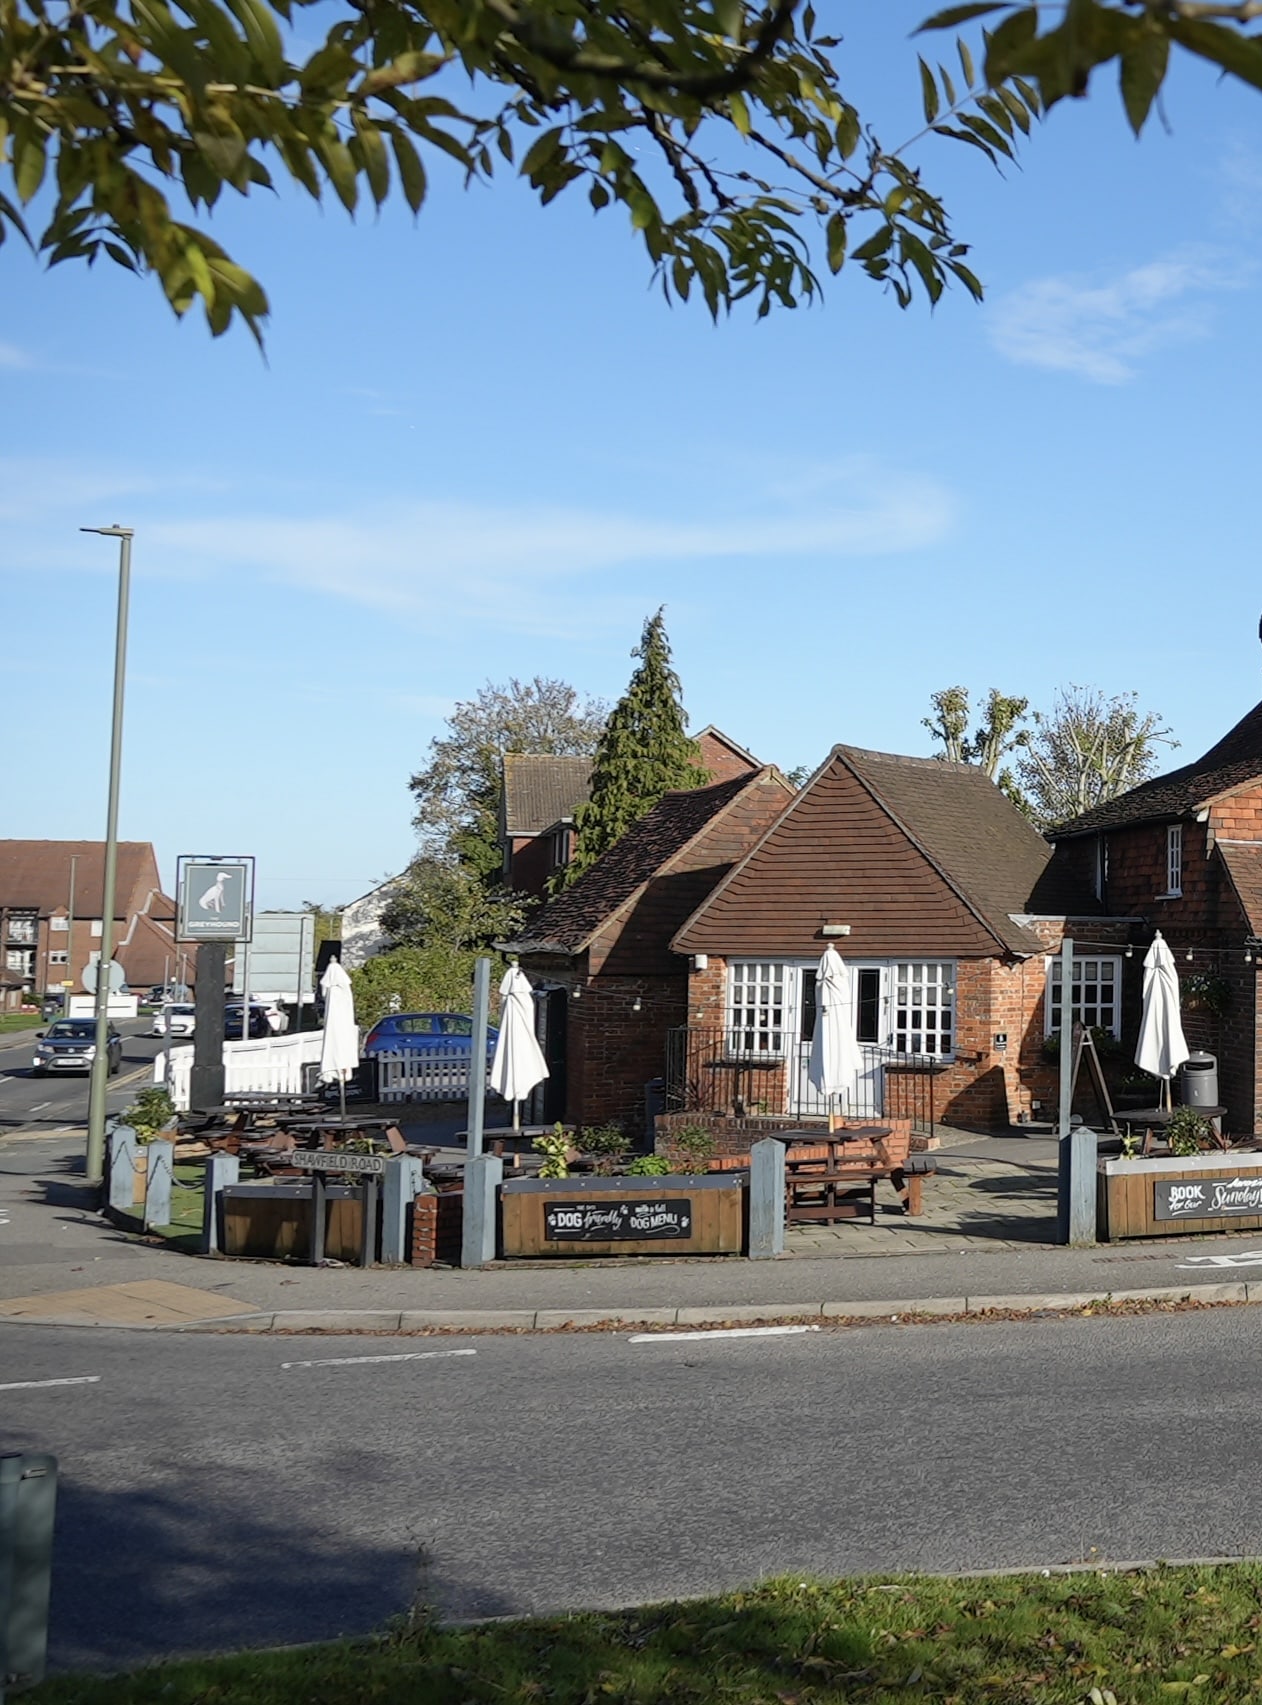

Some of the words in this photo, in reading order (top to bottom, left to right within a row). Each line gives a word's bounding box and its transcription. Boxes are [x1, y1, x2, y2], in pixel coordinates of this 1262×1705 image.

[294, 1153, 347, 1169] SHAWFIELD
[351, 1157, 381, 1171] ROAD
[1168, 1185, 1206, 1202] BOOK
[1211, 1185, 1260, 1210] Sunday
[557, 1212, 582, 1227] DOG
[584, 1209, 622, 1231] friendly
[630, 1216, 650, 1229] DOG
[650, 1213, 678, 1228] MENU
